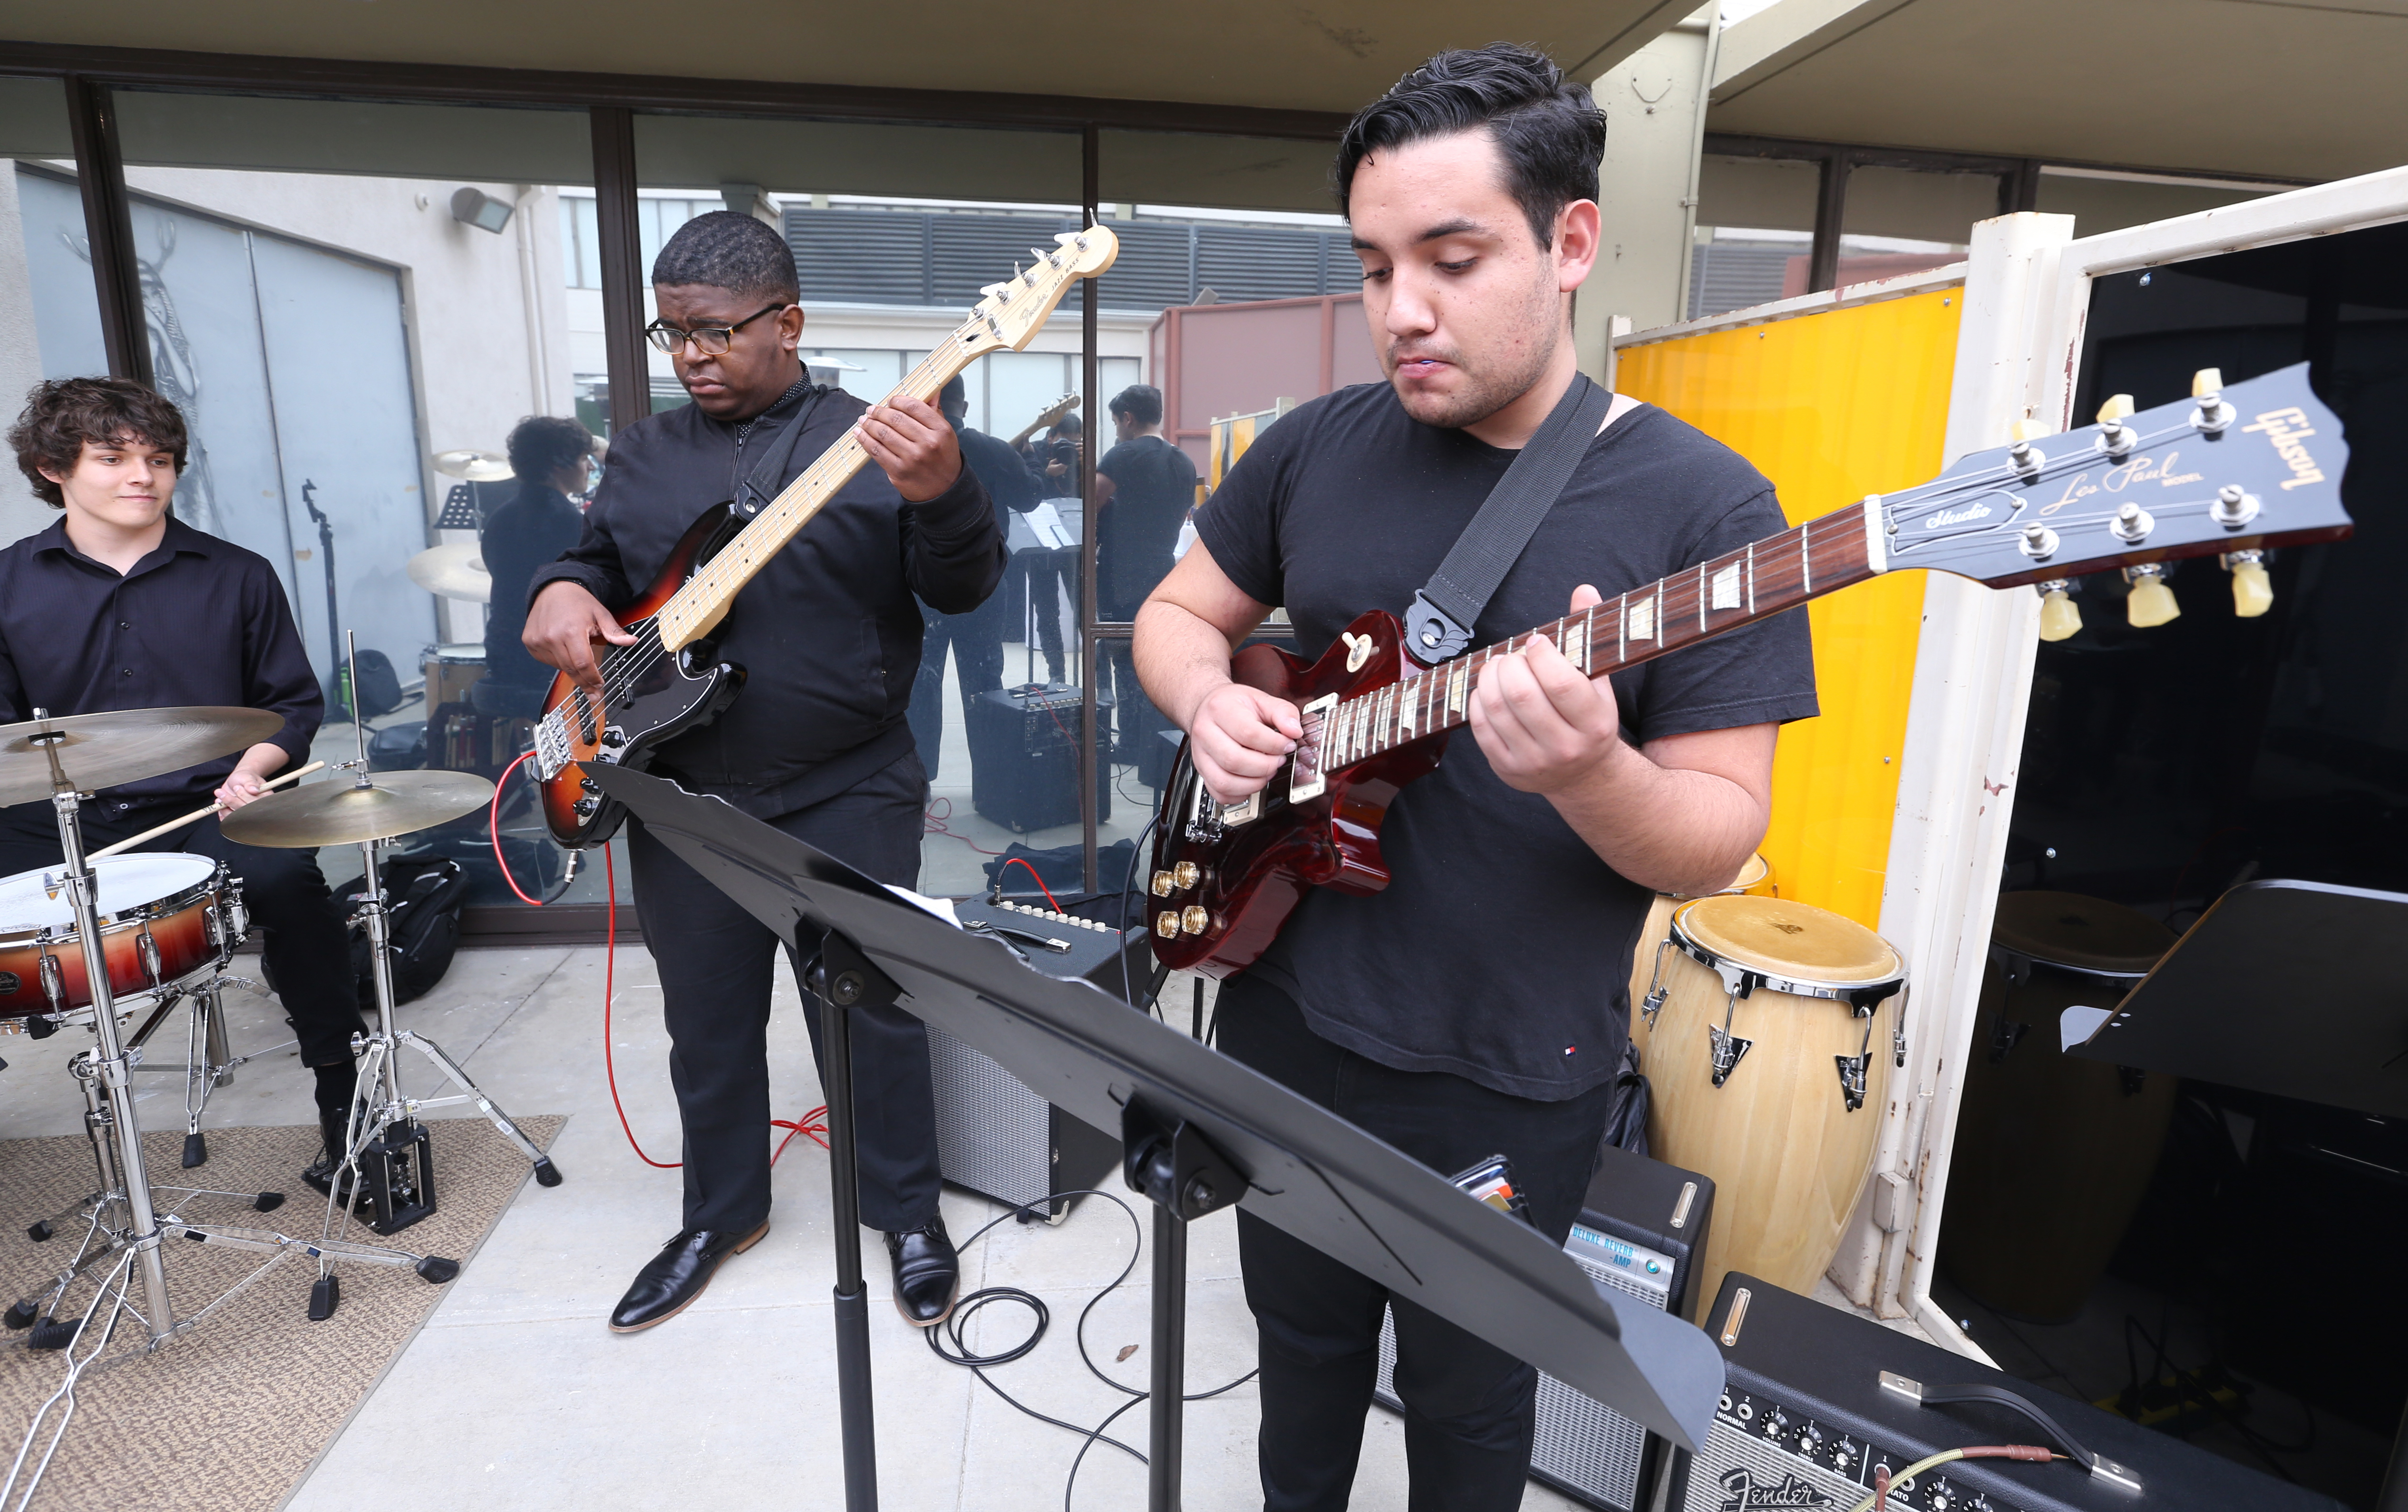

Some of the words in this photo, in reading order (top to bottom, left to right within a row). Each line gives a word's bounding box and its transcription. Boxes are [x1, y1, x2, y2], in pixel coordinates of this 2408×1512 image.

[1019, 293, 1049, 328] Fender
[1052, 274, 1064, 291] JAZZ
[1066, 257, 1079, 273] BASS
[2241, 407, 2325, 491] Gibson
[2039, 473, 2100, 516] Les
[2102, 452, 2179, 493] Paul
[2161, 472, 2204, 488] MODEL
[1925, 502, 1992, 529] Studio
[1573, 1227, 1601, 1245] DELUXE
[1717, 1411, 1747, 1430] NORMAL
[1762, 1436, 1781, 1448] VOLUME
[1798, 1452, 1814, 1462] TREBLE
[1834, 1468, 1846, 1477] BASS
[1723, 1471, 1832, 1512] Fender
